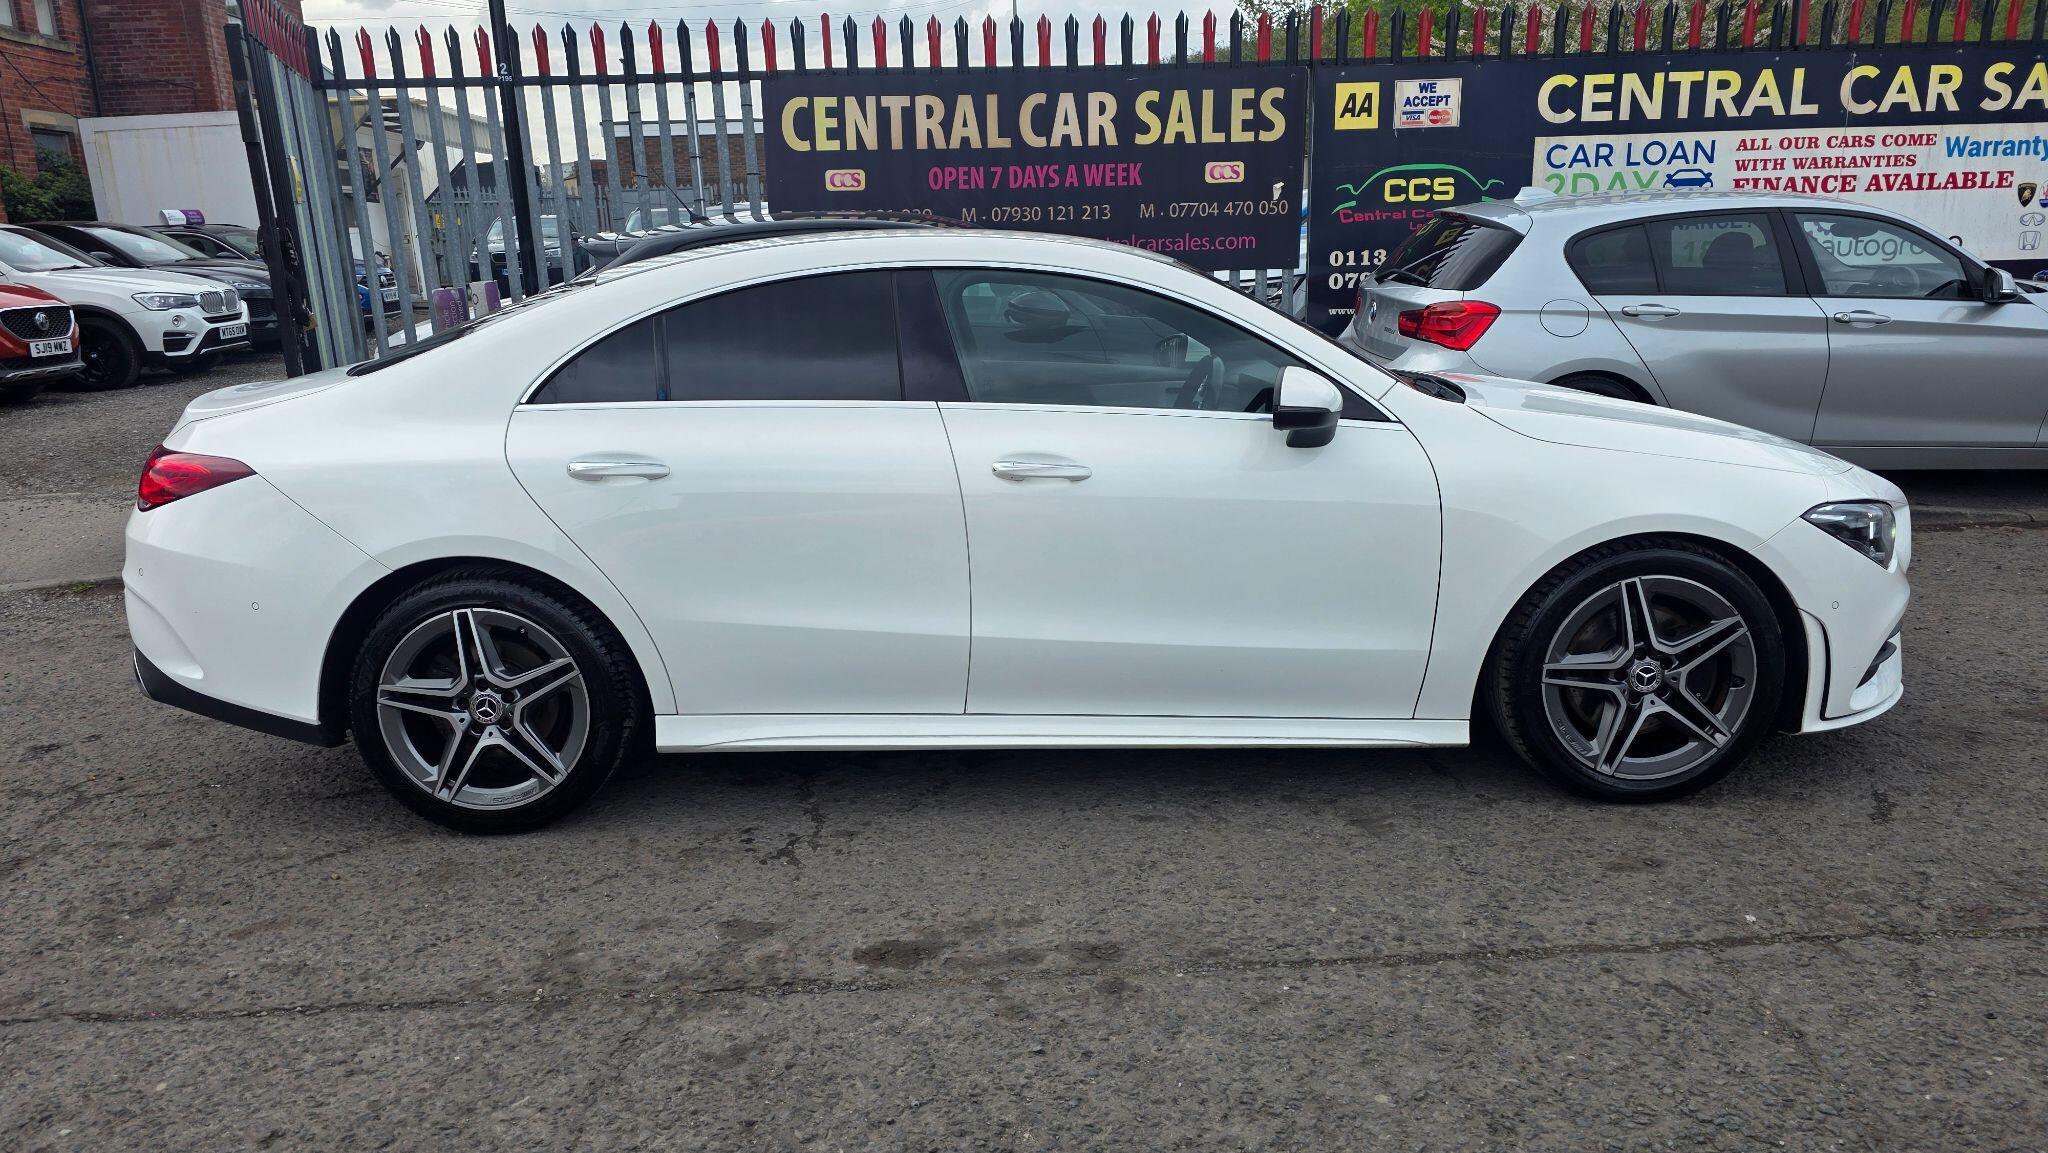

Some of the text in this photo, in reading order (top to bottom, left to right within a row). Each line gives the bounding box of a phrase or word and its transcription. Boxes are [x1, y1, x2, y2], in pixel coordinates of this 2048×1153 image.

[500, 63, 508, 75] 2
[1418, 82, 1438, 94] WE
[1537, 67, 1819, 124] CENTRAL
[1839, 64, 1963, 115] CAR
[1339, 92, 1373, 119] AA
[1403, 94, 1451, 108] ACCEPT
[781, 86, 1287, 152] CENTRAL CAR SALES
[1735, 133, 1937, 152] ALL OUR CARS COME
[1945, 134, 2048, 162] Warranty
[1545, 139, 1717, 169] CAR LOAN
[1734, 154, 1917, 172] WITH WARRANTIES
[829, 172, 862, 188] CCS
[928, 162, 1143, 191] OPEN 7 DAYS A WEEK
[1208, 164, 1241, 181] CCS
[1544, 169, 1660, 196] 2DAY
[1864, 170, 2015, 193] AVAILABLE
[1383, 176, 1455, 203] CCS
[1732, 174, 1858, 194] FINANCE
[962, 207, 977, 222] M
[991, 206, 1042, 222] 07930
[1049, 205, 1074, 221] 121
[1081, 204, 1111, 220] 213
[1139, 203, 1155, 219] M
[1169, 202, 1219, 218] 07704
[1224, 200, 1254, 216] 470
[1259, 199, 1289, 215] 050
[1339, 208, 1407, 224] Central
[1329, 248, 1387, 267] 0113
